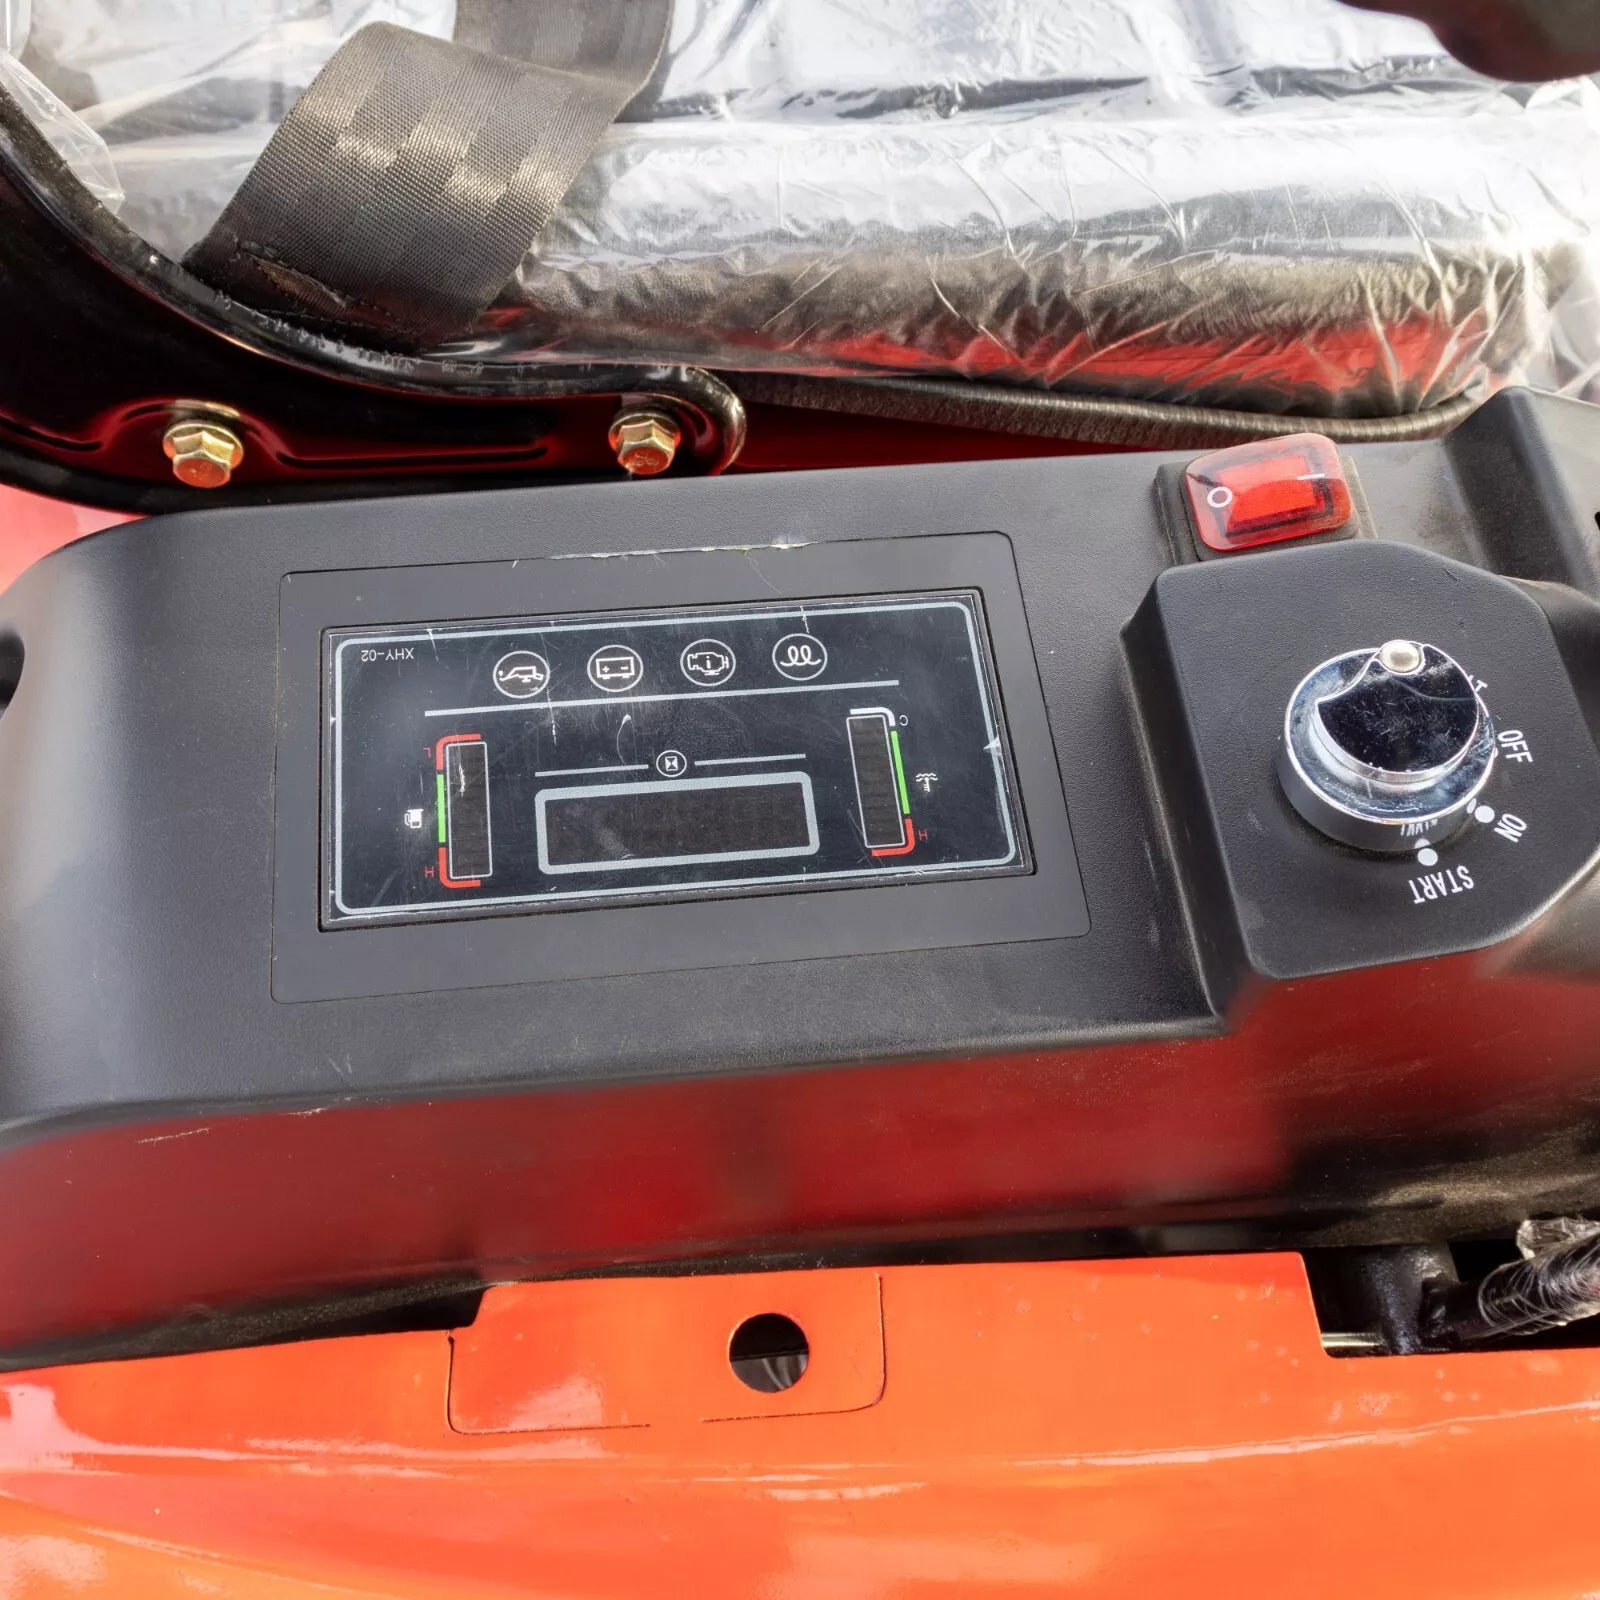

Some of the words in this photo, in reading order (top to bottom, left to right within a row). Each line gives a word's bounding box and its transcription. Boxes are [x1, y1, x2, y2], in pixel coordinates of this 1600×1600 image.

[361, 647, 414, 662] XHY-02
[1497, 729, 1534, 763] OFF
[918, 829, 929, 841] H
[1493, 813, 1527, 843] ON
[424, 865, 435, 878] H
[1408, 865, 1475, 904] START
